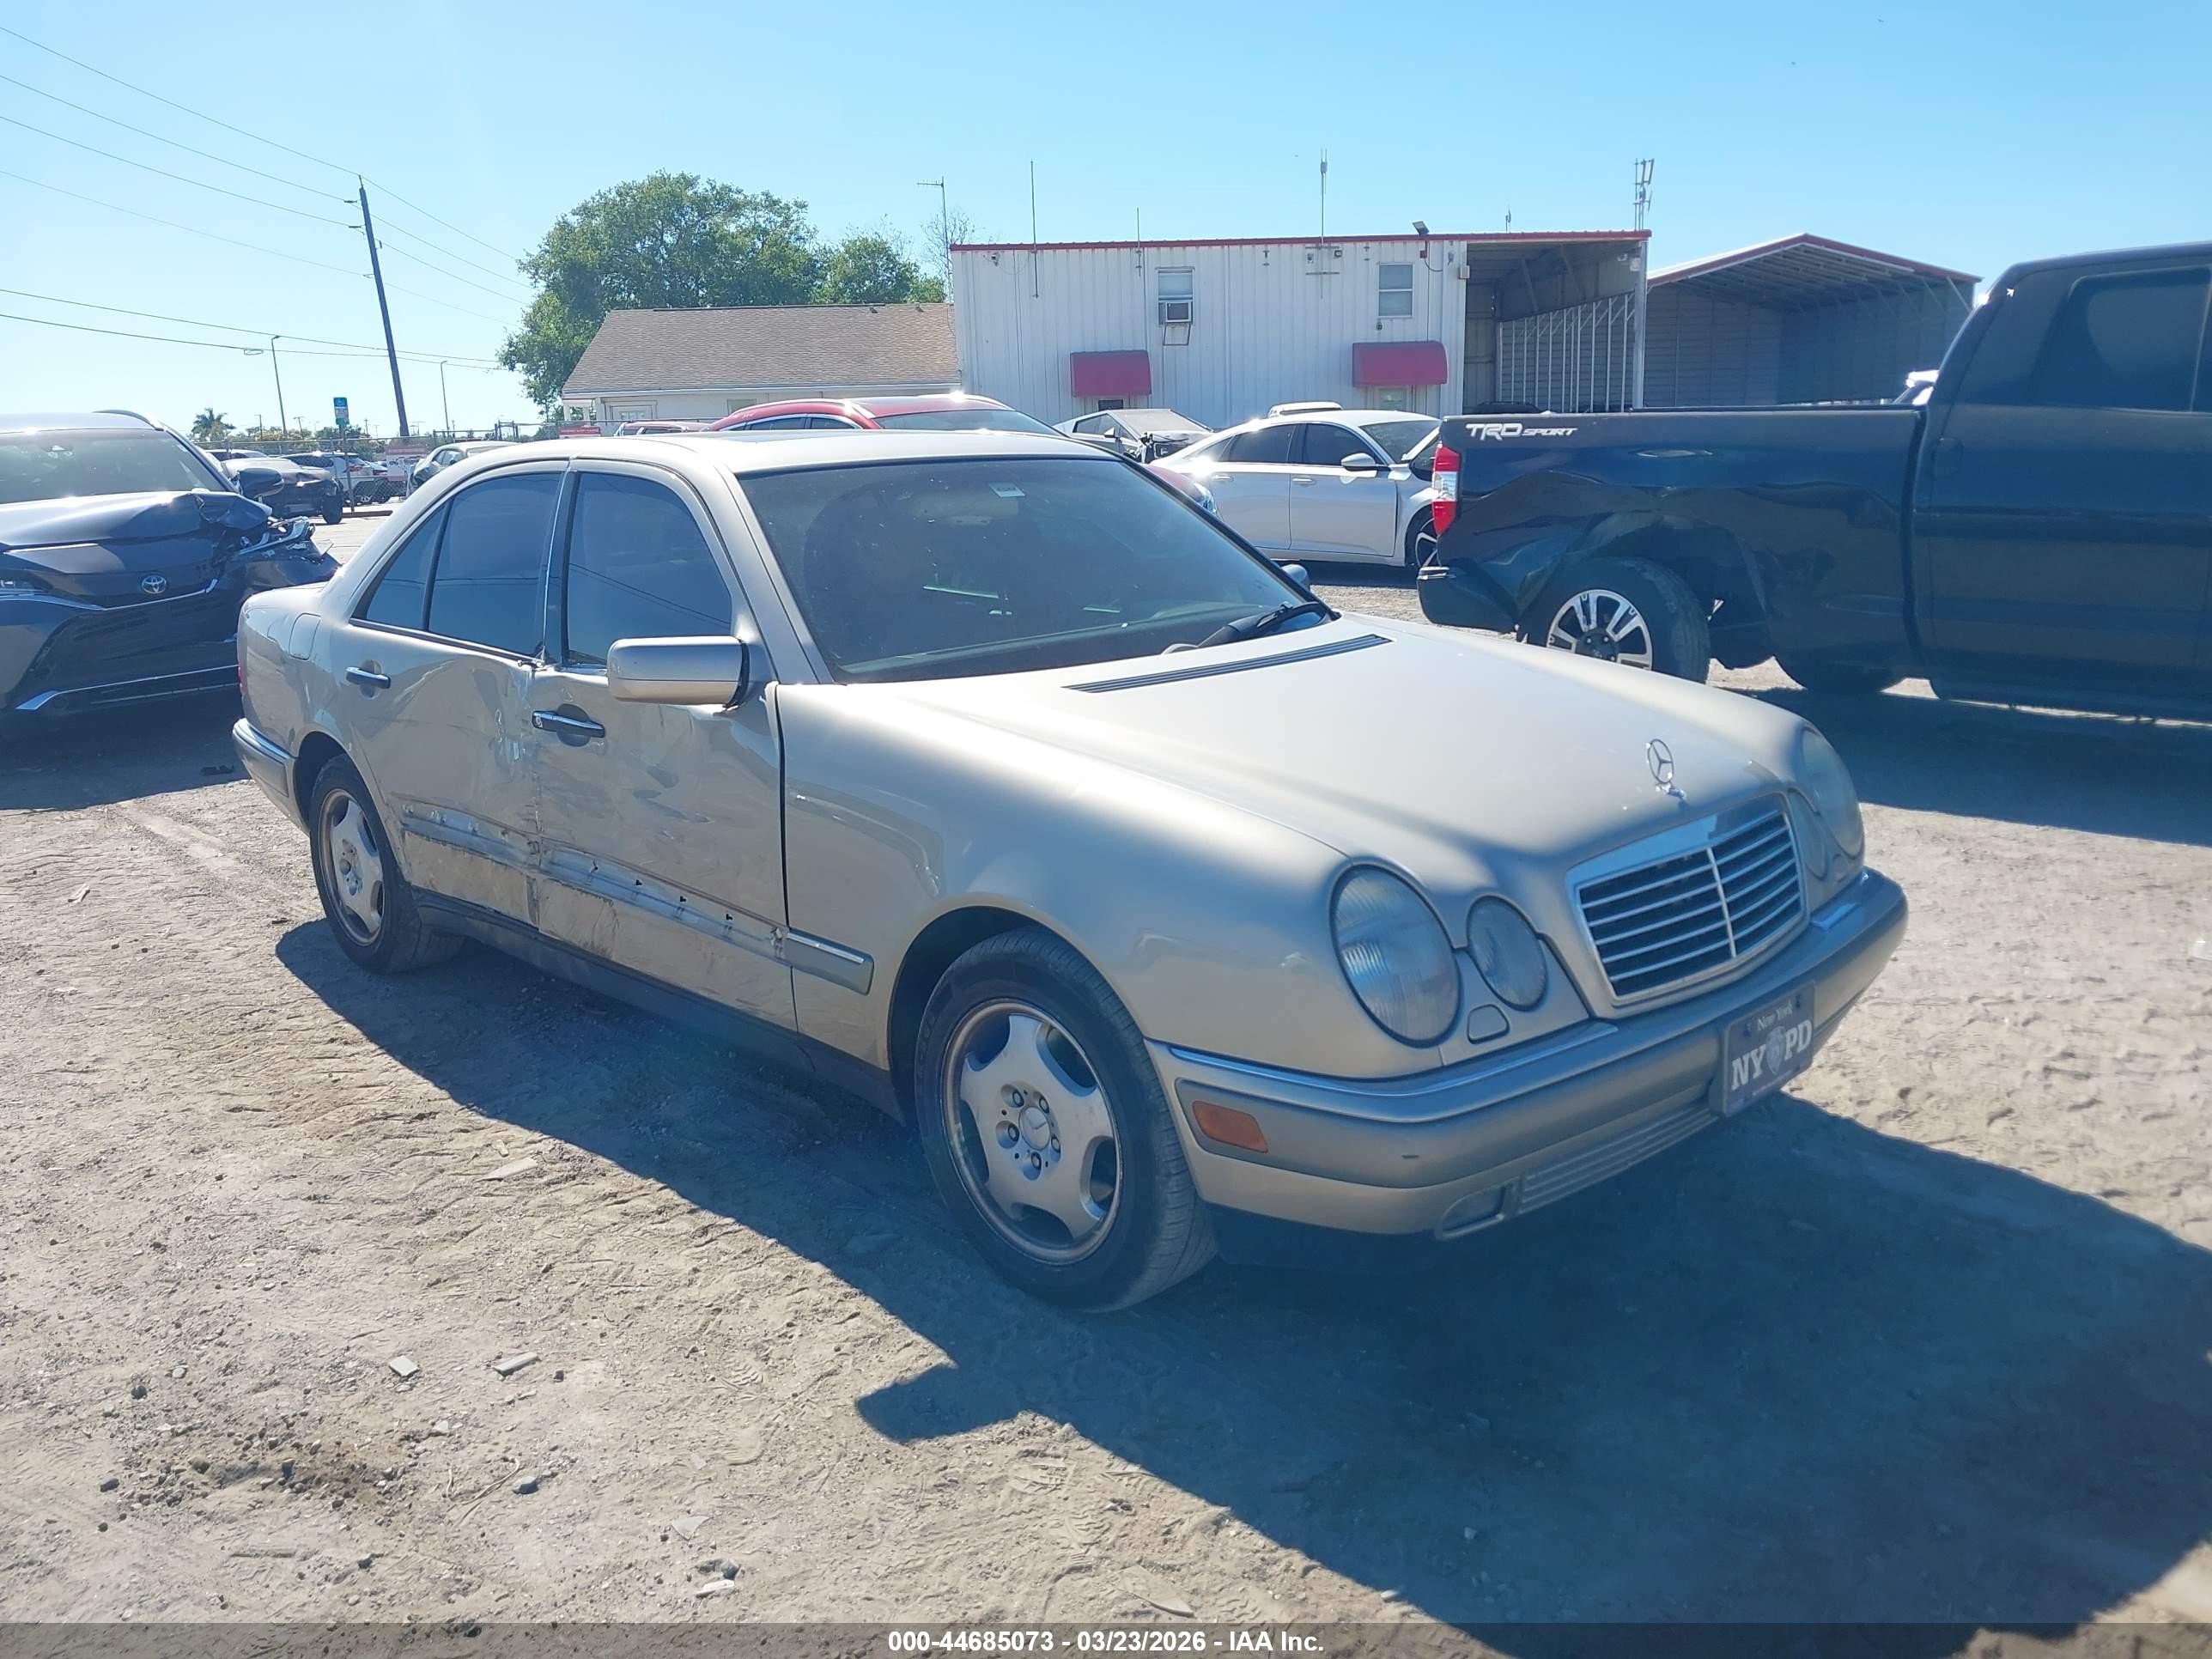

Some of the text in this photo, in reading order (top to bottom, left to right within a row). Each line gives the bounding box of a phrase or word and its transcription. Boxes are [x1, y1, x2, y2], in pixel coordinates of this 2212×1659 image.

[1466, 422, 1578, 441] TRD SPORT
[1757, 1000, 1793, 1031] New York
